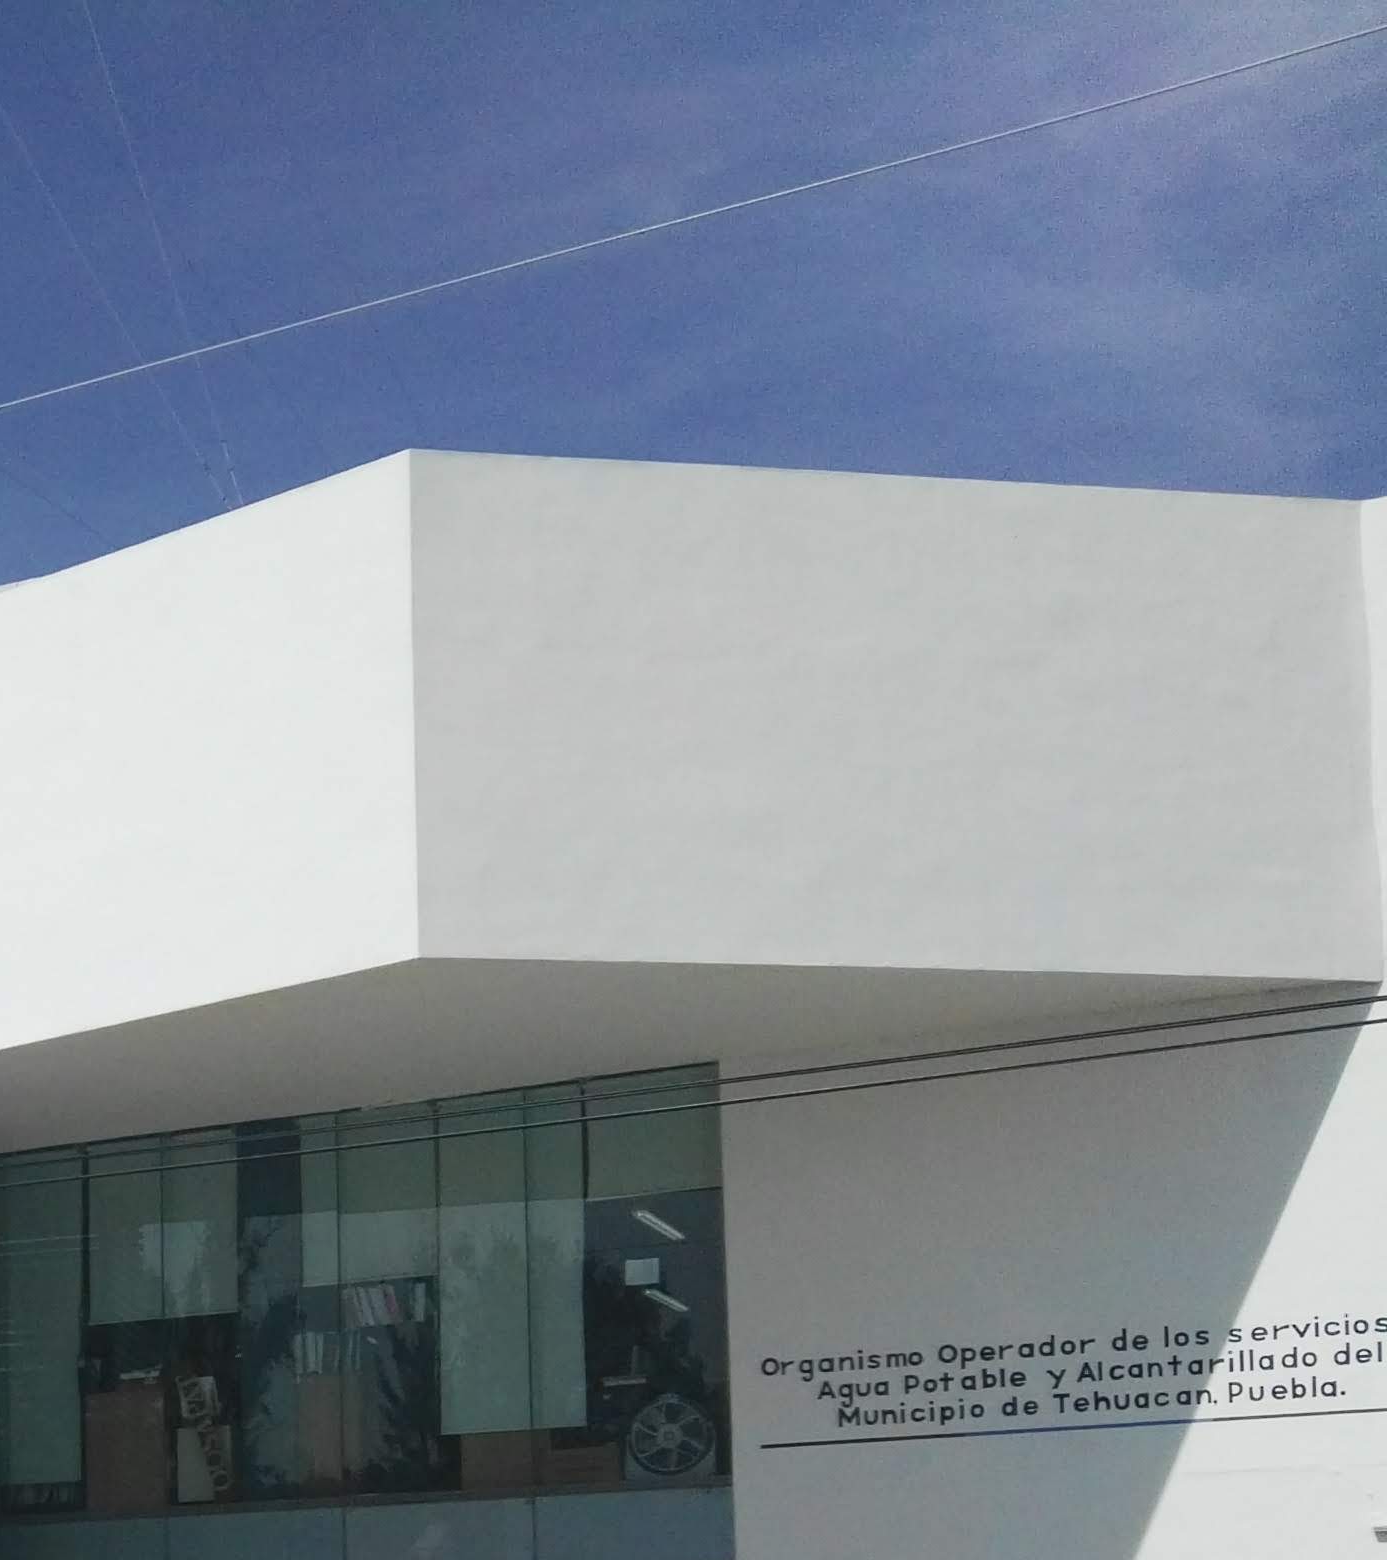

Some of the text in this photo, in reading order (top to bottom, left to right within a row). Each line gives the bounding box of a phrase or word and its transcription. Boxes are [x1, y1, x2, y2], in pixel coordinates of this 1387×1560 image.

[760, 1350, 924, 1382] Organismo
[938, 1335, 1095, 1369] Operador
[1112, 1328, 1149, 1351] de
[1164, 1326, 1210, 1348] los
[817, 1342, 1383, 1408] Agua Potable y Alcantarillado del
[838, 1399, 984, 1427] Municipio
[1002, 1396, 1039, 1416] de
[1228, 1376, 1346, 1403] Puebla.
